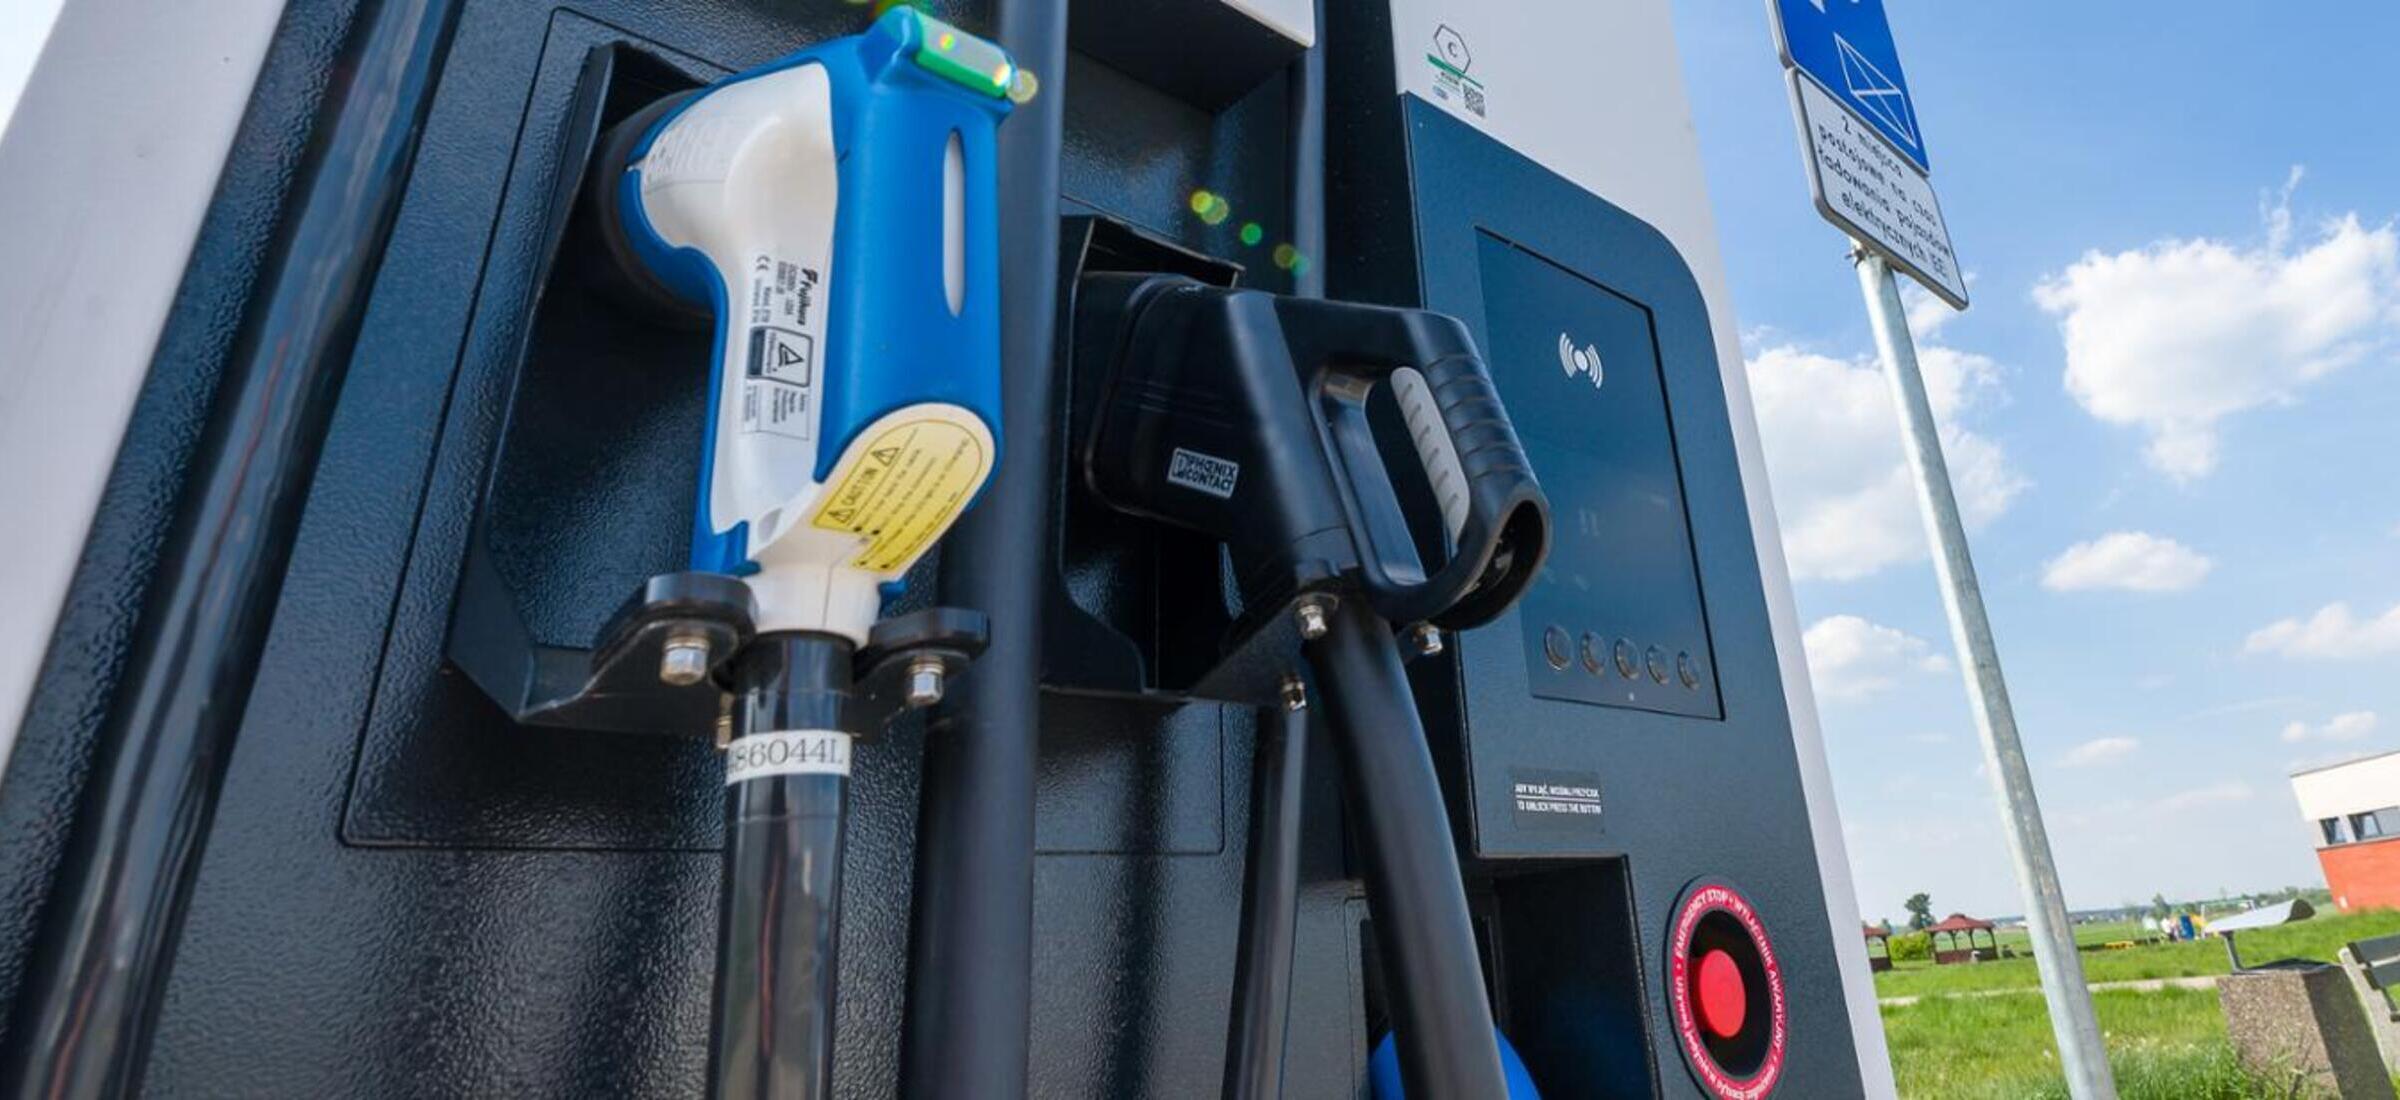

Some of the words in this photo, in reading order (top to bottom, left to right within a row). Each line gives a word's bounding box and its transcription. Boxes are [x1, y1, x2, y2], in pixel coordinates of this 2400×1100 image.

[1841, 115, 1852, 134] 2
[842, 467, 878, 507] CAUTION
[1187, 468, 1232, 491] CONTACT
